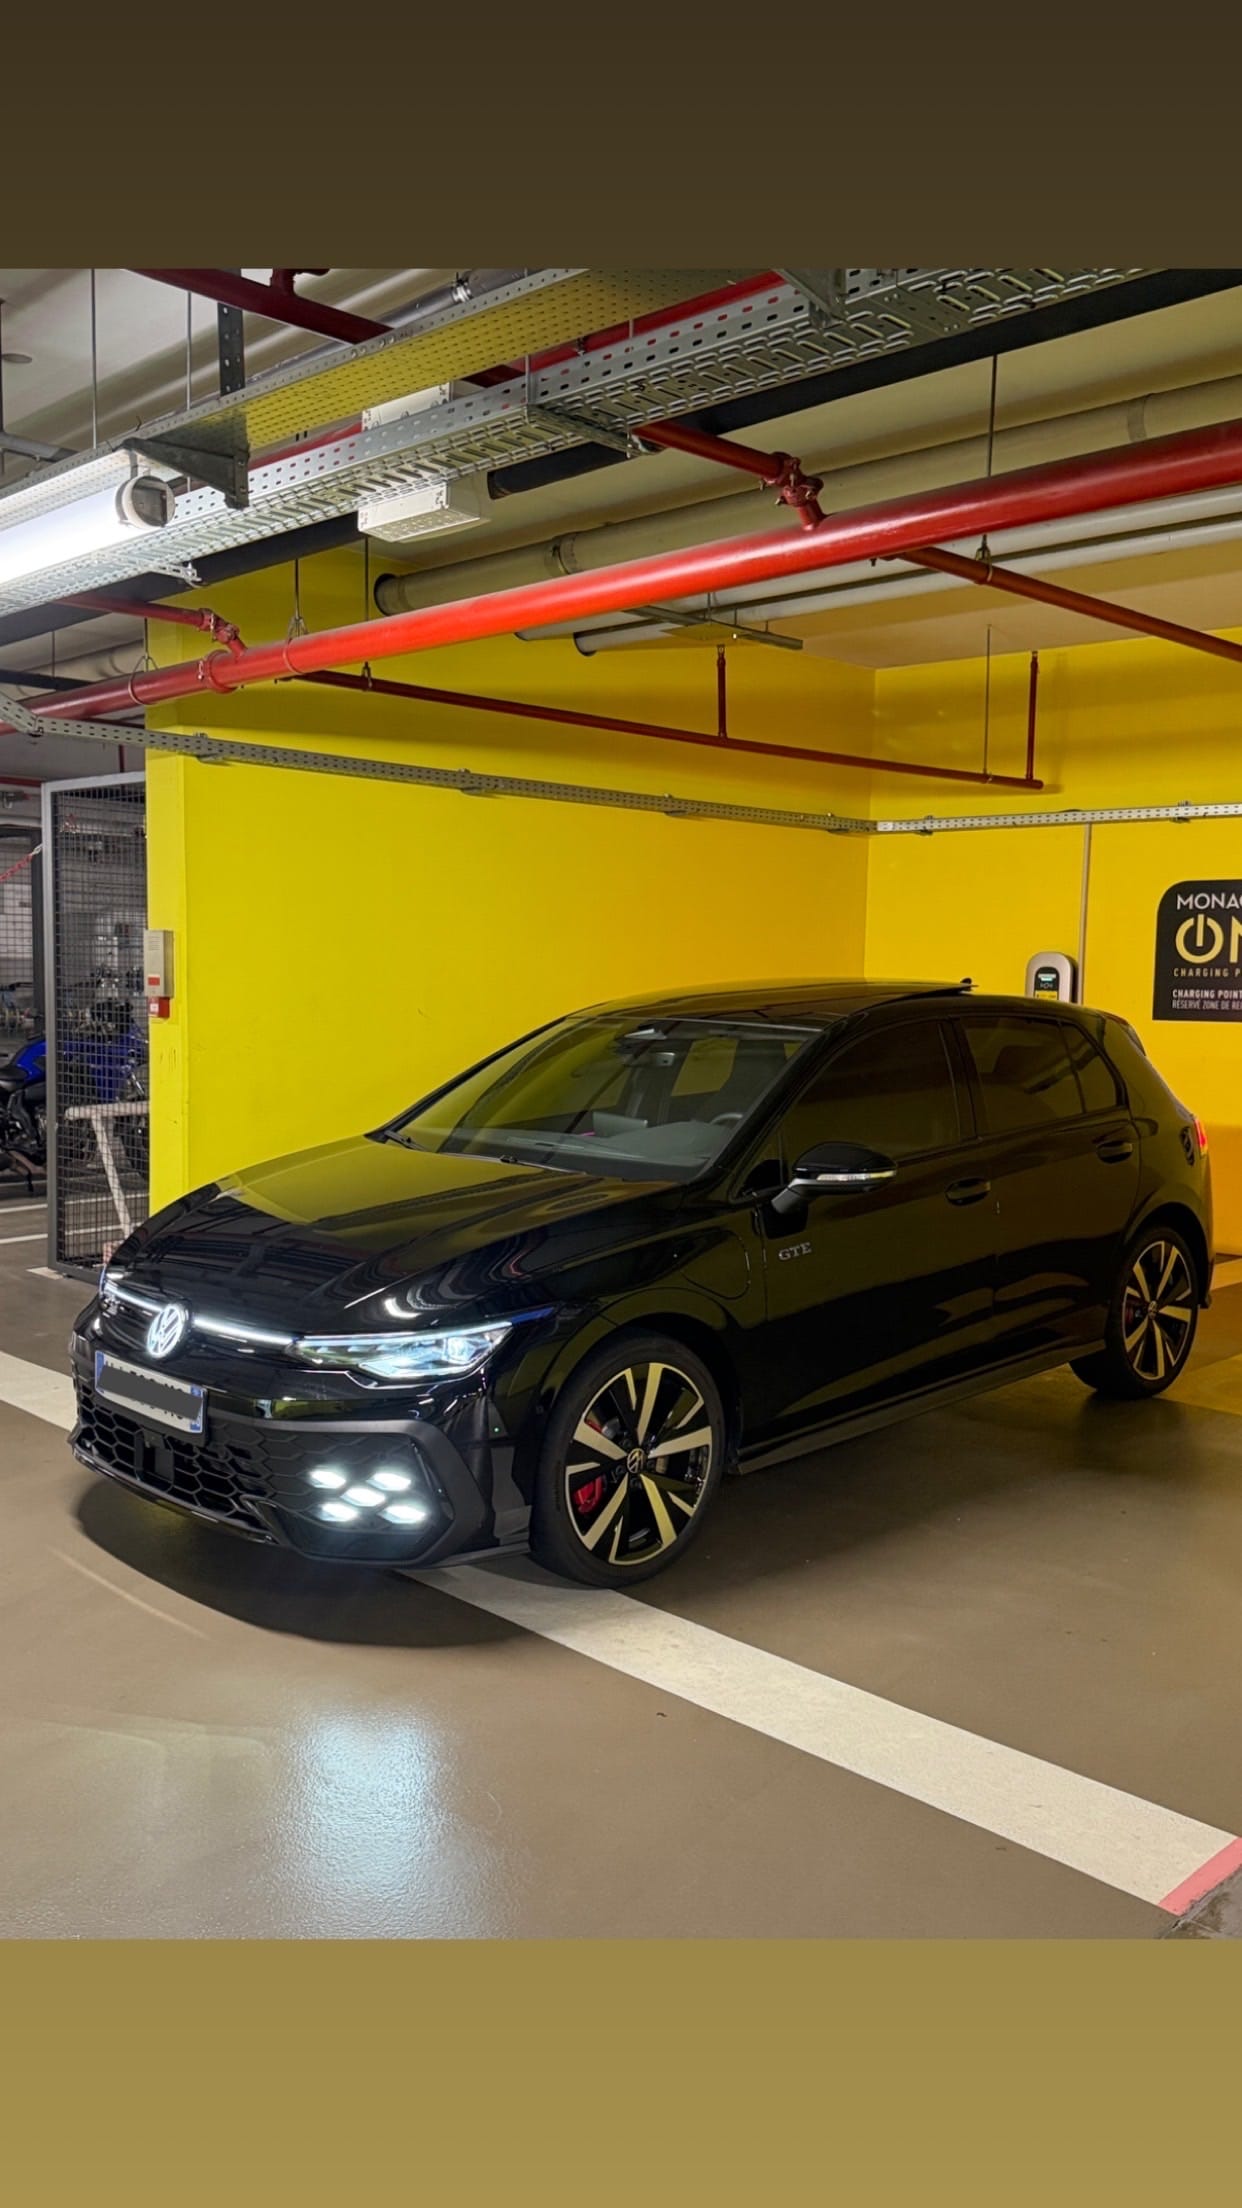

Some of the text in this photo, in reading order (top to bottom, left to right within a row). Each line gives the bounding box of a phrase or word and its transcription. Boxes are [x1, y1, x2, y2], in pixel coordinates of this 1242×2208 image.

[1176, 892, 1242, 910] MONA
[1173, 967, 1230, 978] CHARGING
[1172, 988, 1215, 999] CHARGING
[778, 1242, 812, 1261] GTE
